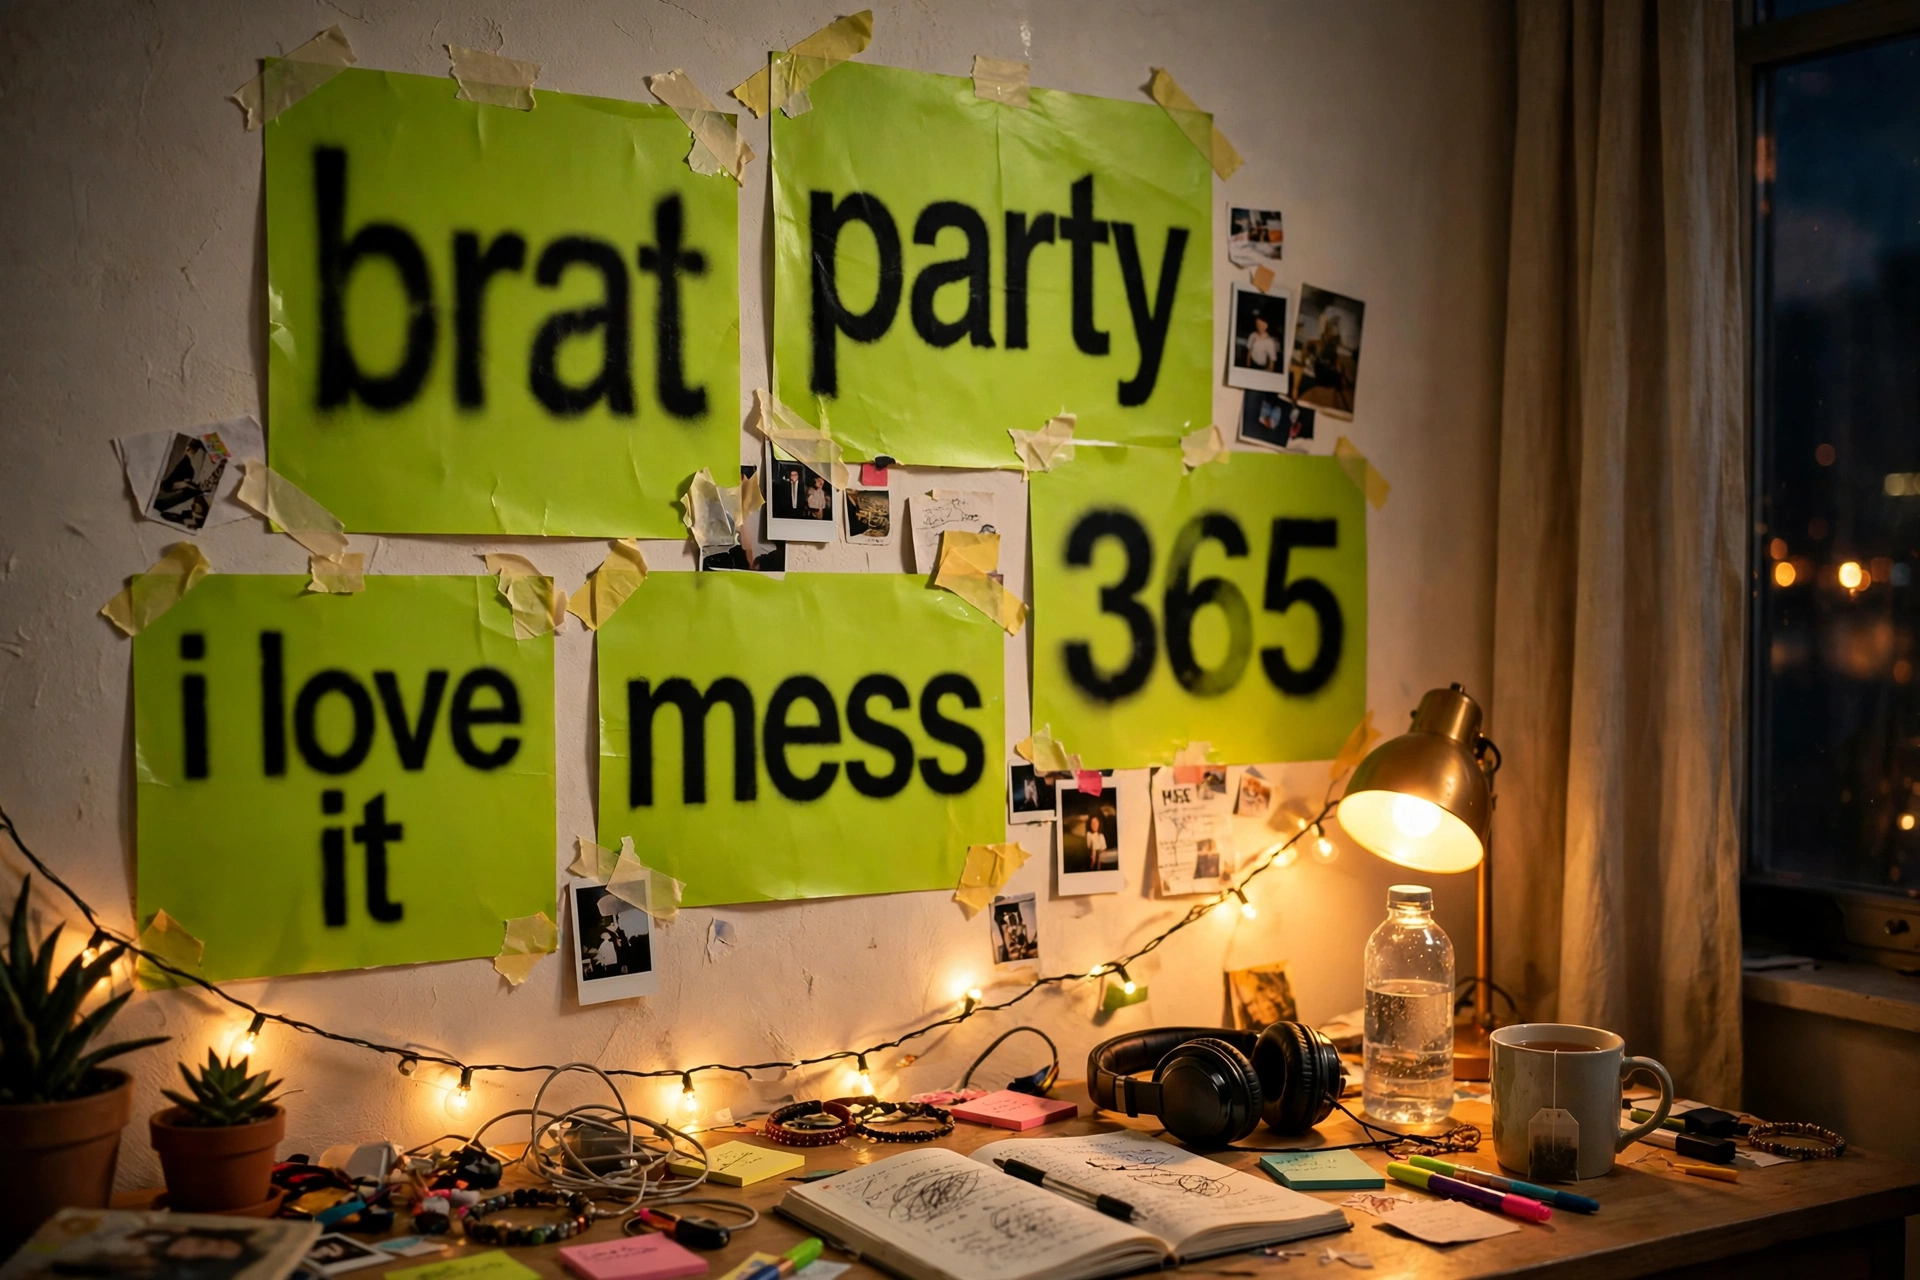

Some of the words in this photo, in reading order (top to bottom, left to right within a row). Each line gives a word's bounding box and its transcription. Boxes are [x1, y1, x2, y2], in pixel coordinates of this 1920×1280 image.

[309, 142, 709, 420] brat
[808, 172, 1189, 407] party
[1062, 508, 1346, 704] 365
[179, 630, 211, 781] i
[259, 629, 523, 778] love
[627, 672, 985, 810] mess
[320, 788, 404, 929] it
